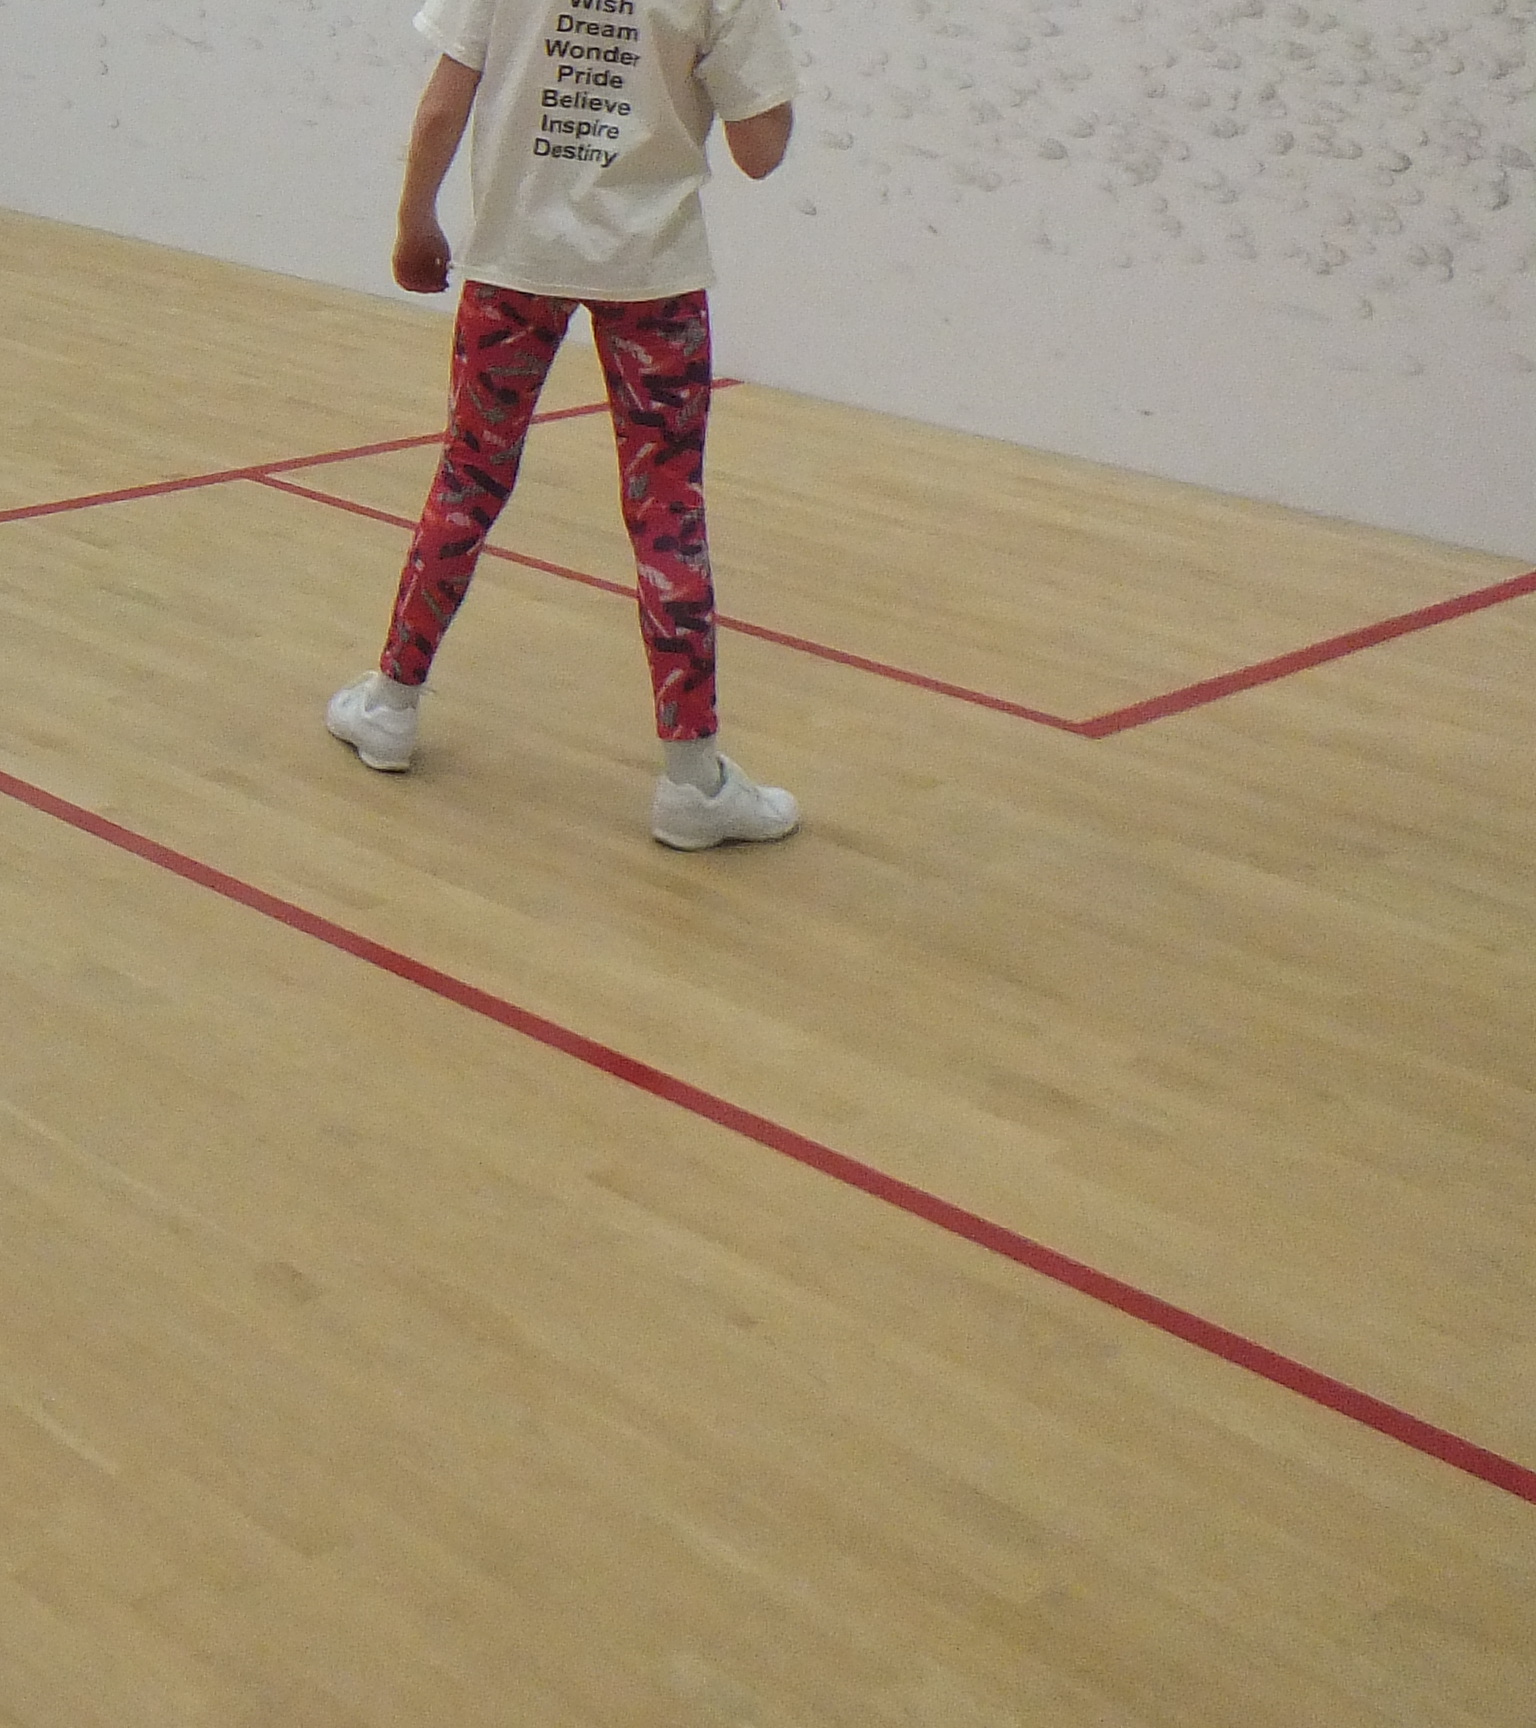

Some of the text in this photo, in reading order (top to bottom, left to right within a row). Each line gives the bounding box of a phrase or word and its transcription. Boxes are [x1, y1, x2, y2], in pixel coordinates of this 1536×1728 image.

[556, 14, 640, 41] Dream
[544, 38, 641, 67] Wonder
[556, 65, 624, 89] Pride
[541, 89, 632, 116] Believe
[541, 114, 620, 140] Inspire
[533, 137, 618, 168] Destiny
